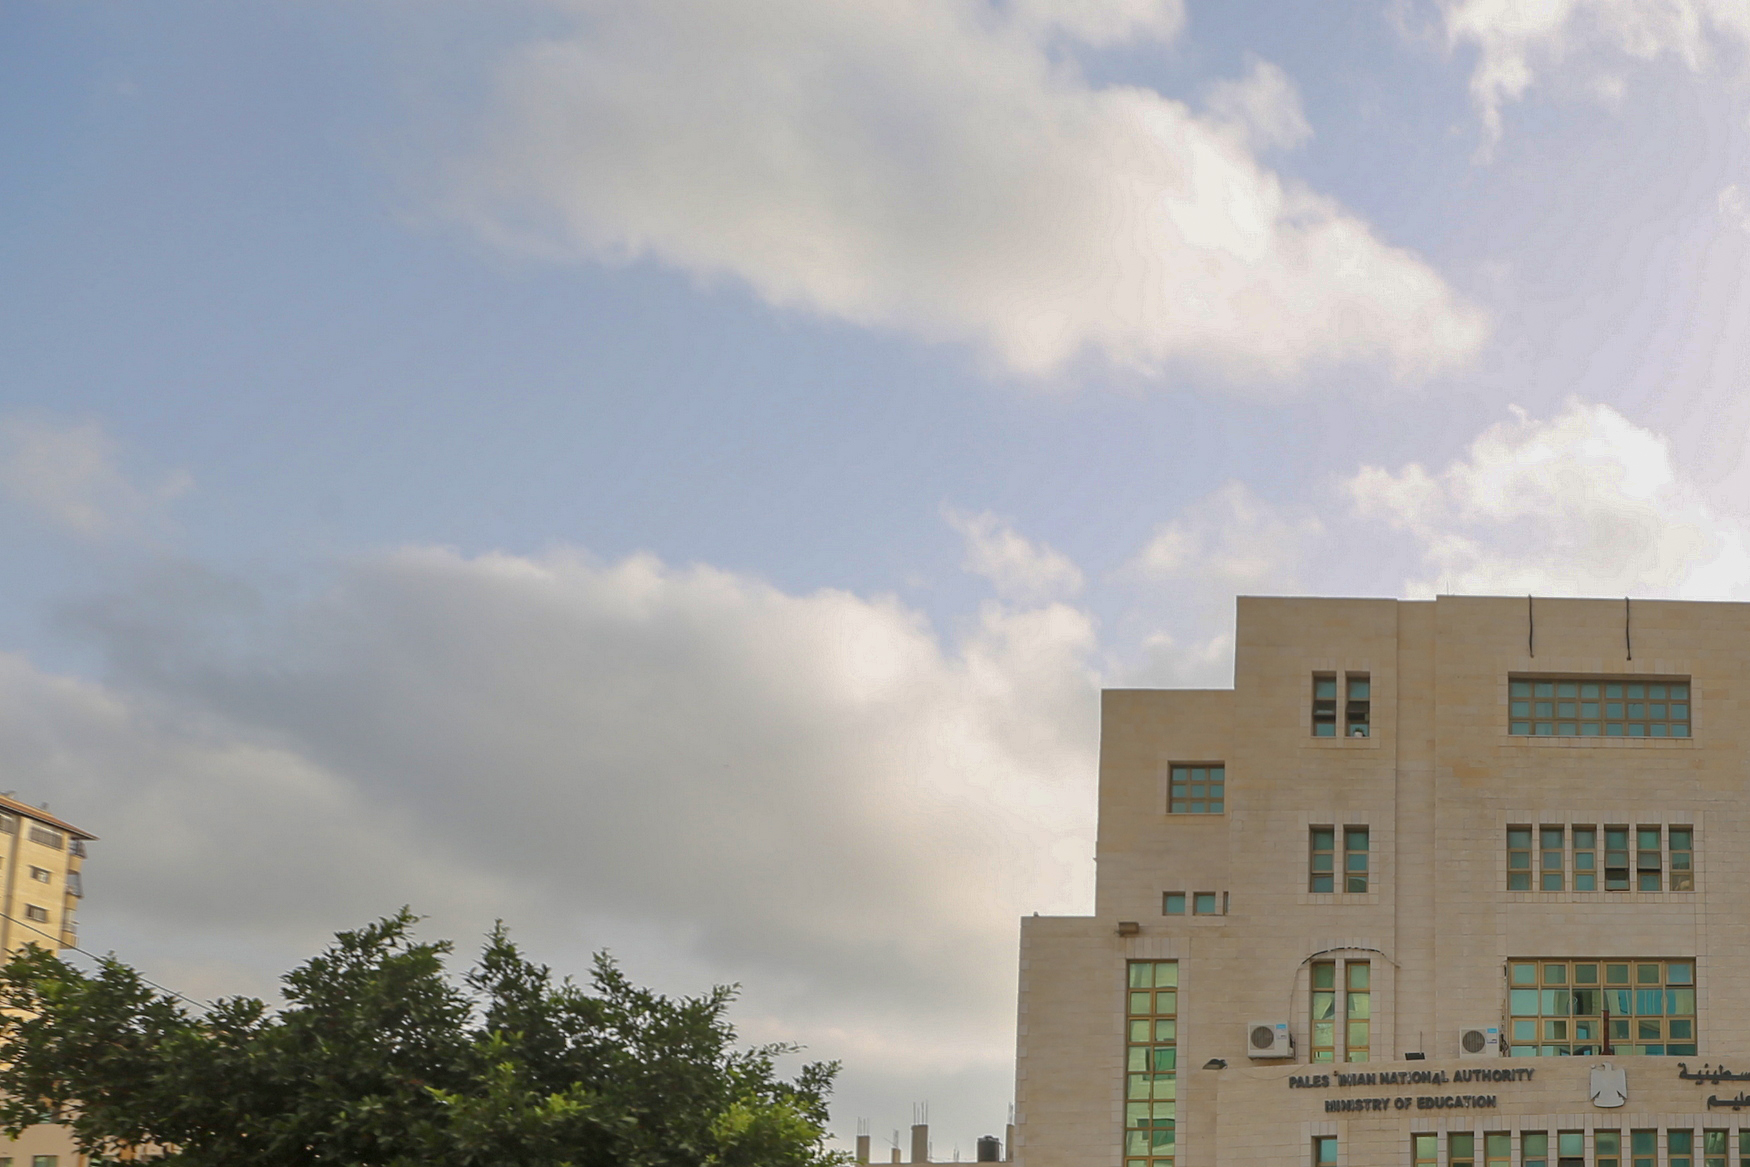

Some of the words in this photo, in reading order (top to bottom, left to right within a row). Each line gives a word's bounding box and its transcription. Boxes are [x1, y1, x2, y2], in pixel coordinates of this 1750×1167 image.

[1380, 1070, 1449, 1086] NATIONAL
[1453, 1068, 1535, 1082] AUTHORITY
[1324, 1098, 1390, 1113] MINISTRY
[1394, 1097, 1412, 1110] OF
[1417, 1095, 1497, 1109] EDUCATION
